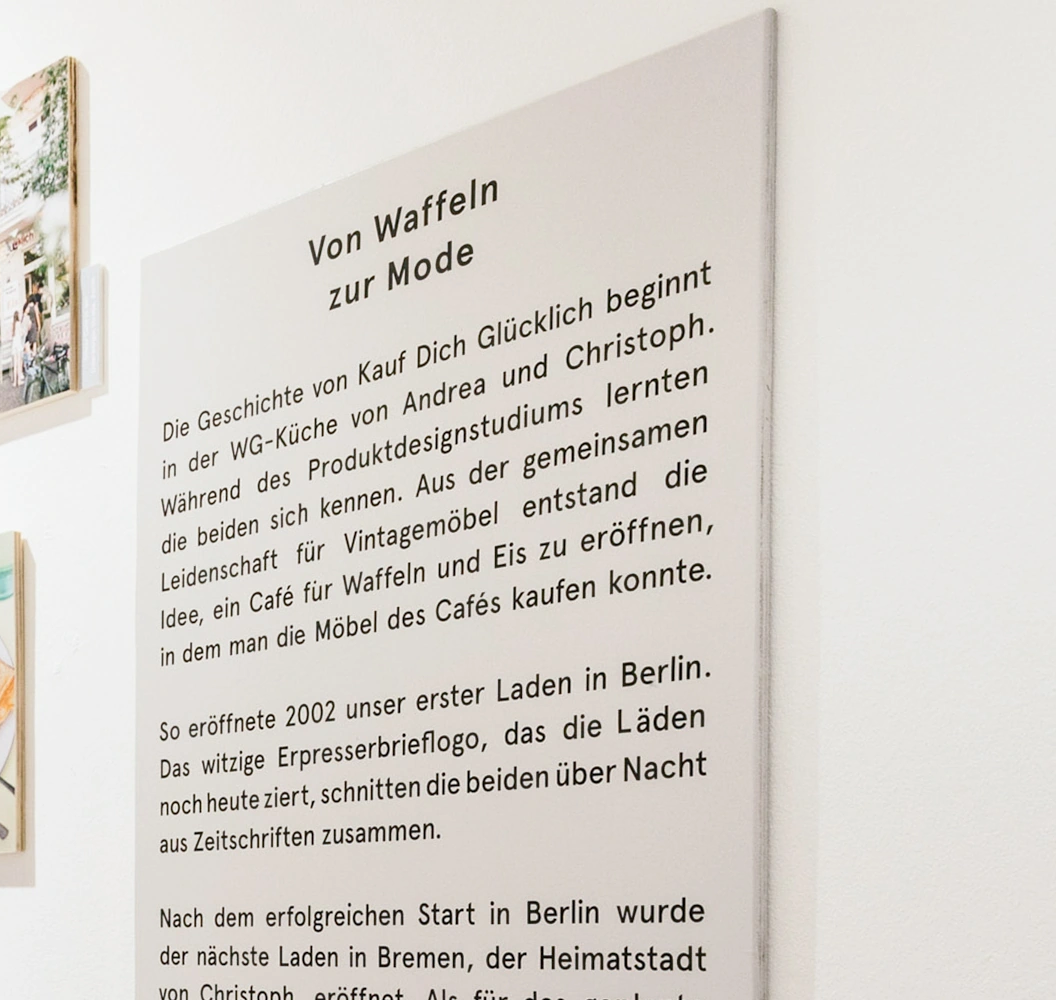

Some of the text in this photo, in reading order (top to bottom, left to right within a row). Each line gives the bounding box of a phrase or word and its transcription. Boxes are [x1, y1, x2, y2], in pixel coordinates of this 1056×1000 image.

[307, 177, 498, 267] Von Waffeln
[328, 239, 475, 312] zur Mode
[162, 259, 712, 443] Die Geschichte von Kauf Dich Glücklich beginnt
[160, 364, 709, 518] Während des Produktdesignstudiums lernten
[162, 312, 715, 481] in der WG-Küche von Andrea und Christoph.
[160, 513, 714, 630] Idee, ein Café für Waffeln und Eis zu eröffnen,
[159, 654, 712, 742] So eröffnete 2002 unser erster Laden in Berlin.
[160, 704, 706, 780] Das witzige Erpresserbrieflogo, das die Läden
[159, 821, 442, 854] aus Zeitschriften zusammen.
[159, 944, 707, 974] der nächste Laden in Bremen, der Heimatstadt
